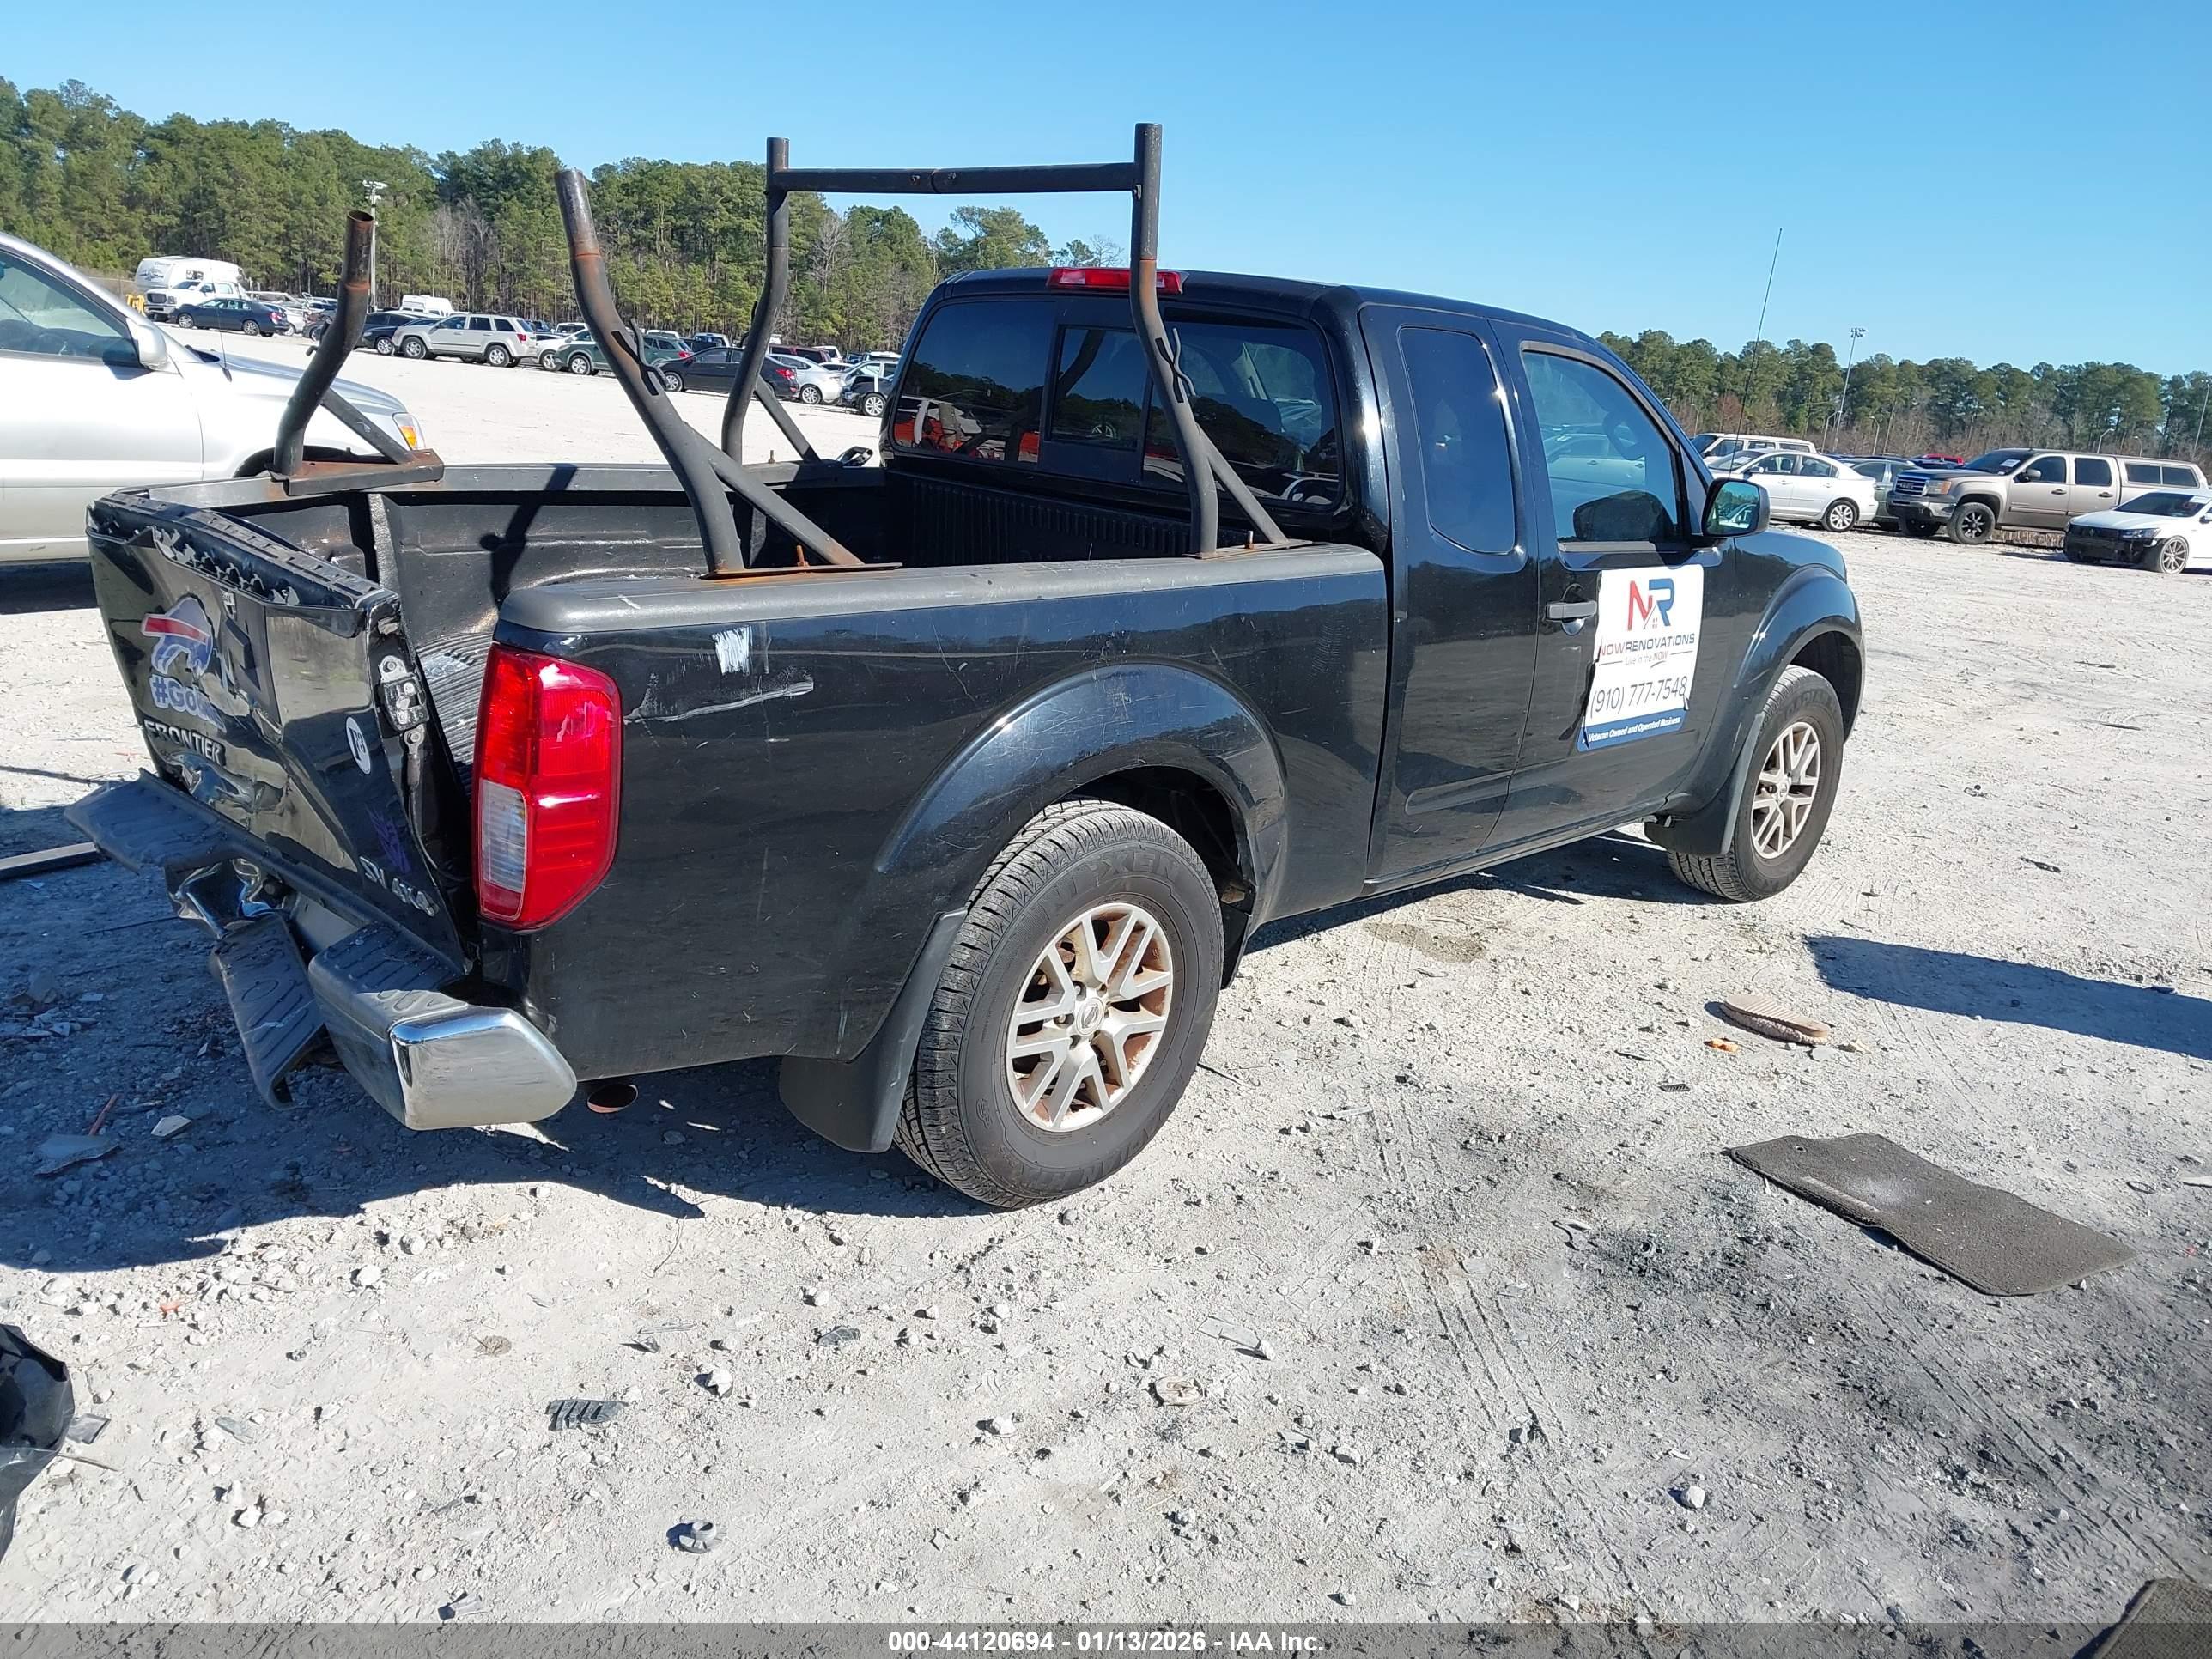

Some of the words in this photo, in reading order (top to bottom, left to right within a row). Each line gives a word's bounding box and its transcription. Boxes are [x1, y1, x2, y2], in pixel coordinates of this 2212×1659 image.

[1600, 633, 1695, 657] NOWRENOVATIONS
[1653, 651, 1668, 661] NOW
[1590, 686, 1625, 719] (910)
[1628, 675, 1688, 707] 777-7548
[143, 719, 223, 766] FRONTIER
[1588, 732, 1609, 743] Veteran
[1608, 726, 1628, 738] Owned
[1628, 724, 1638, 734] and
[1638, 720, 1661, 732] Operated
[1660, 716, 1681, 727] Business
